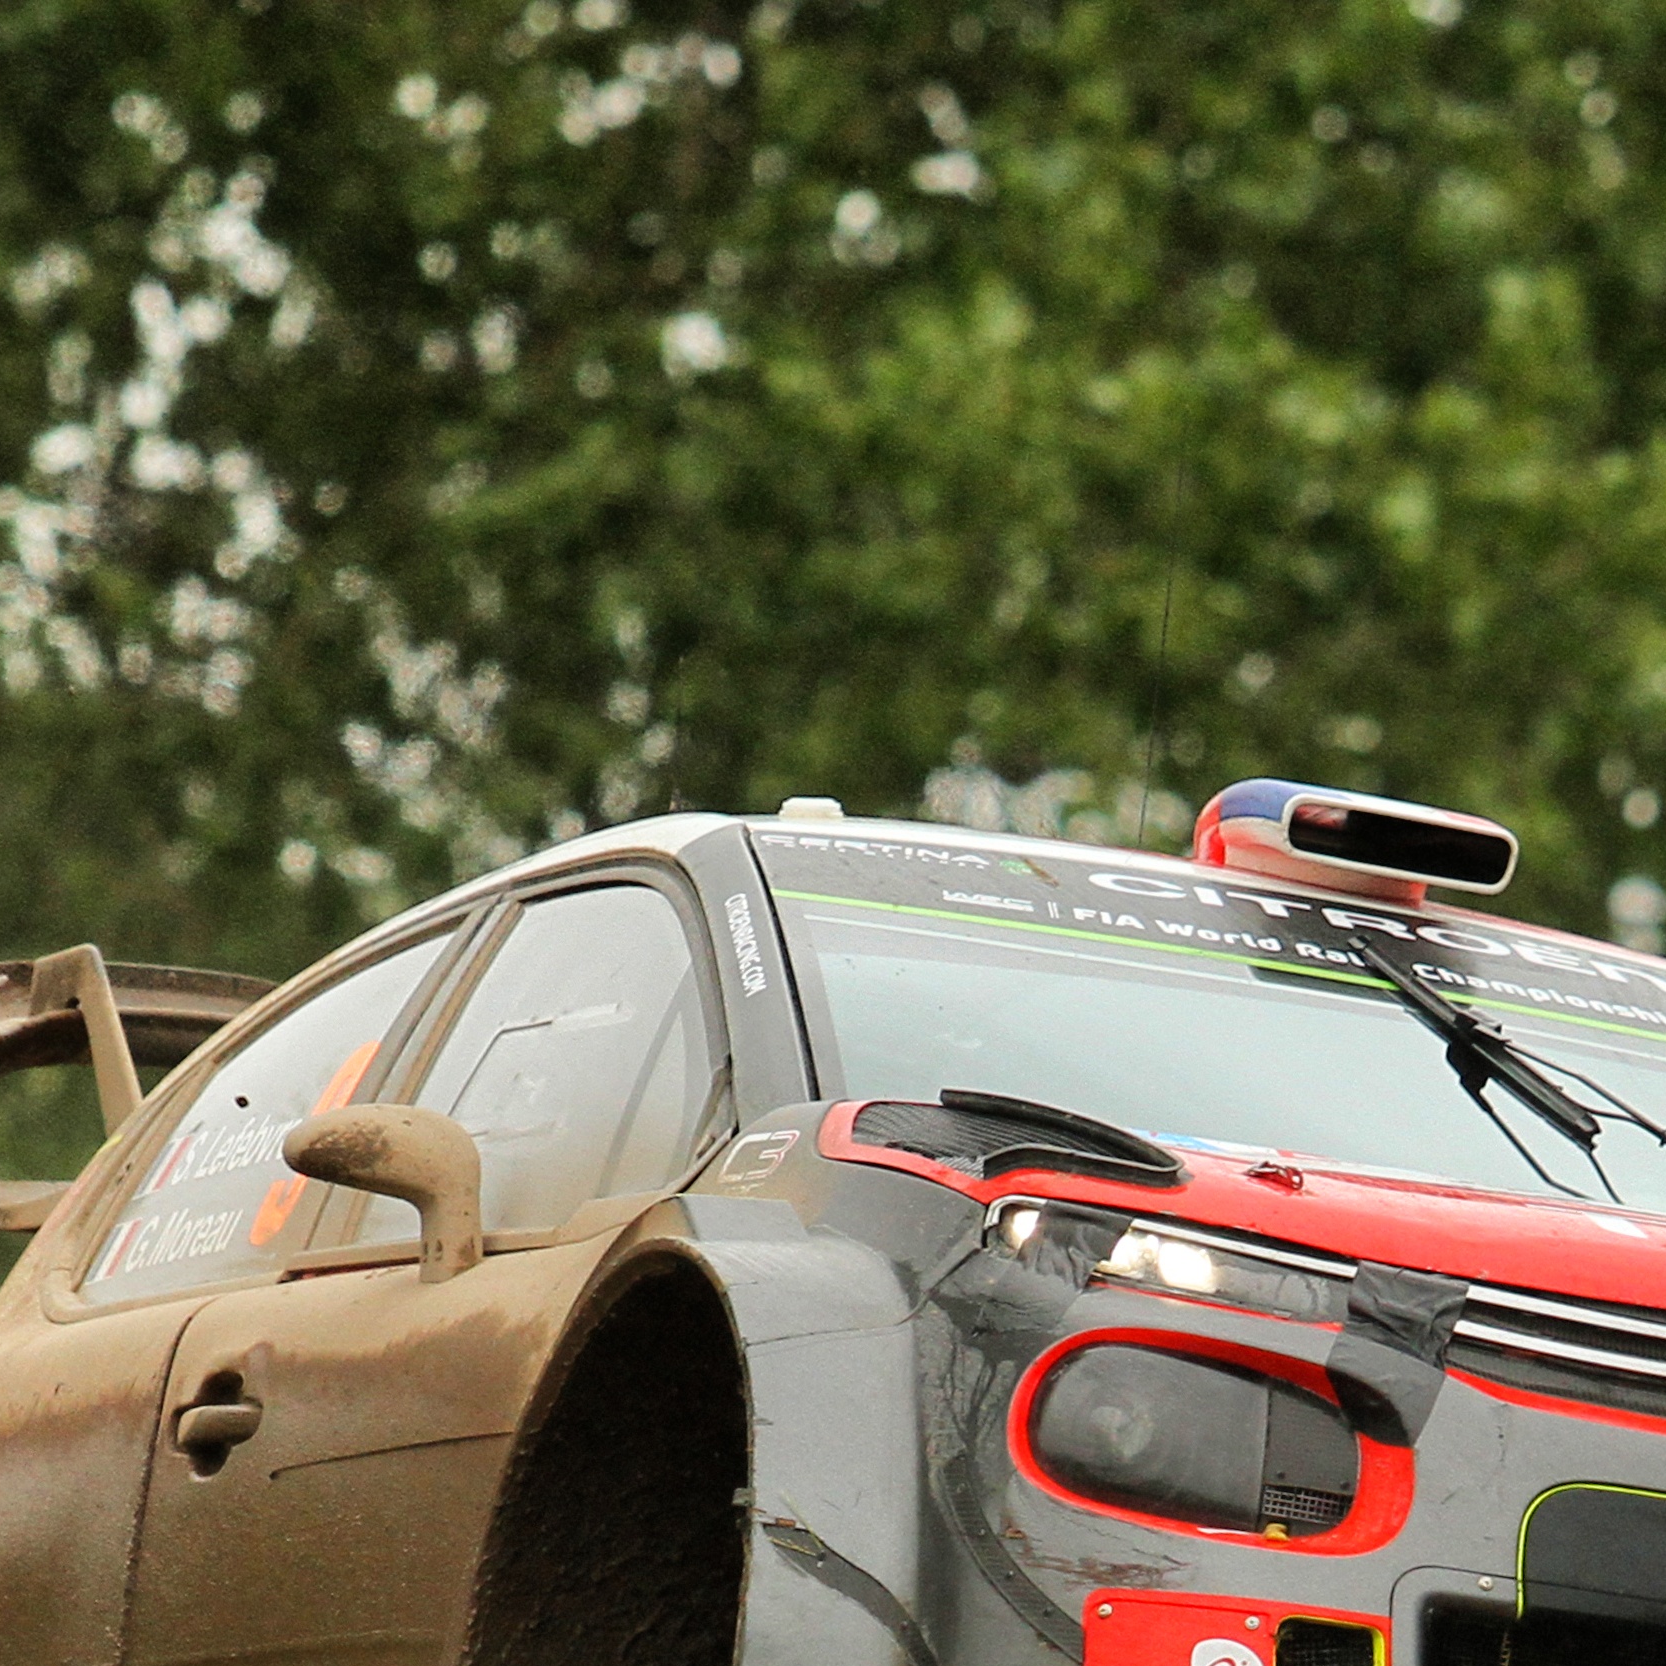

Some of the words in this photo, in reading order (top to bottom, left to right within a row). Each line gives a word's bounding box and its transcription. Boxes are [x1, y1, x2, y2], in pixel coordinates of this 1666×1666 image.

[1072, 908, 1145, 930] FIA
[1155, 919, 1283, 953] World
[1294, 942, 1367, 968] Ral
[146, 1207, 244, 1268] Moreau
